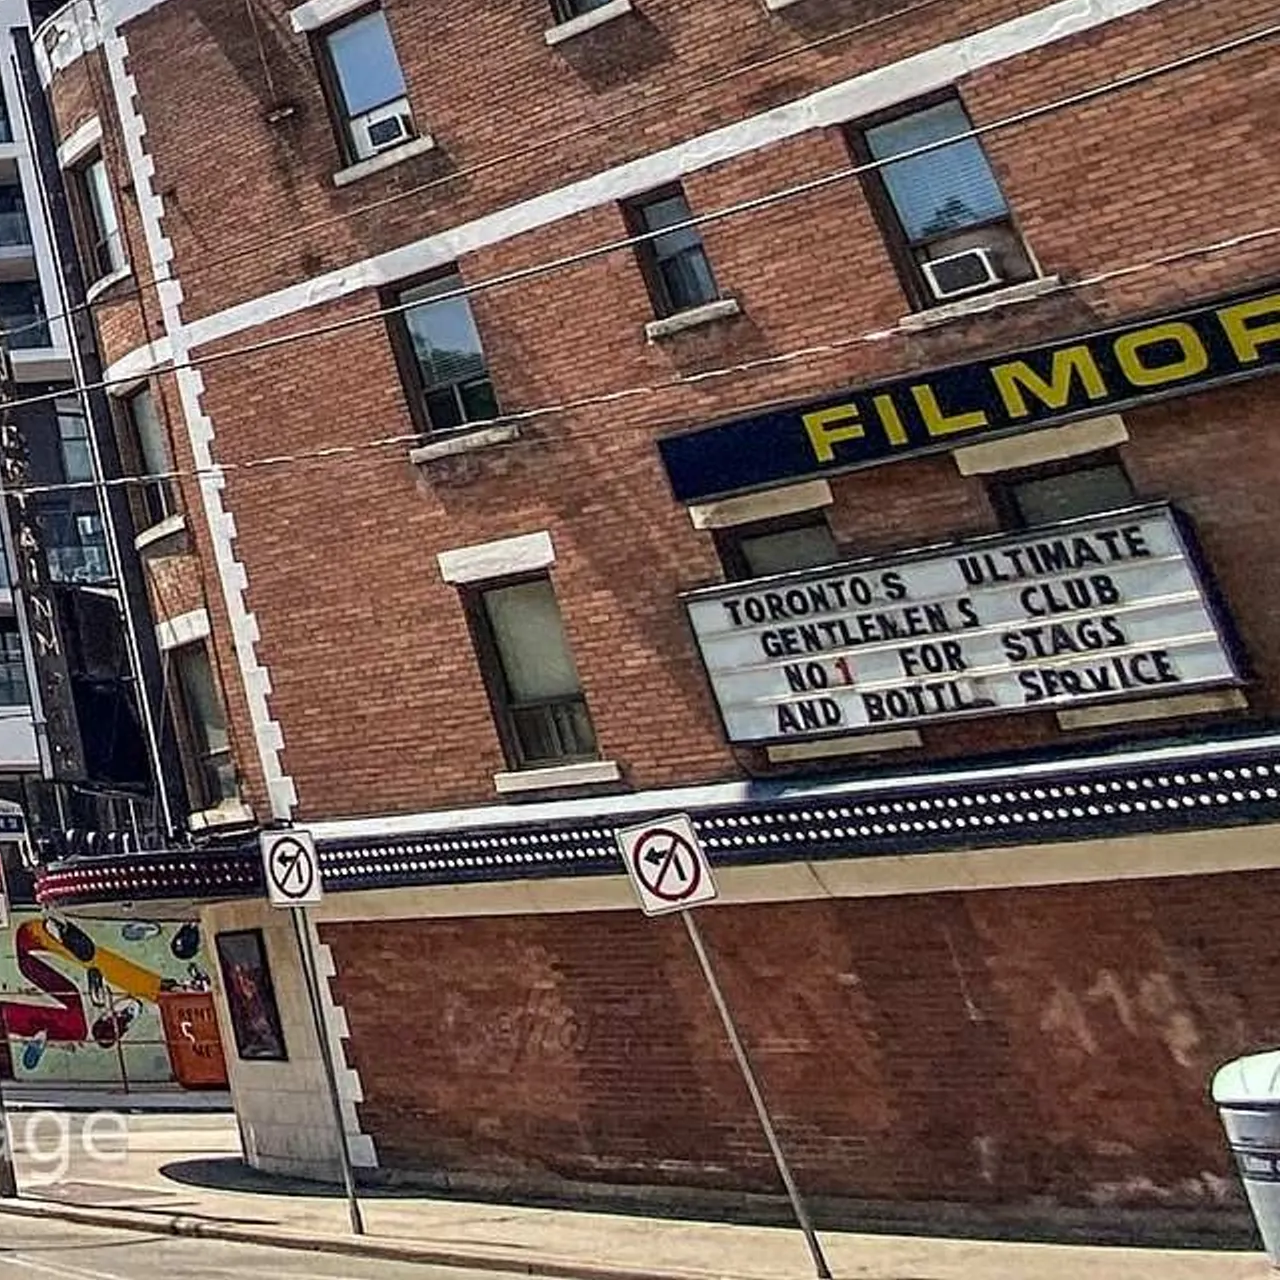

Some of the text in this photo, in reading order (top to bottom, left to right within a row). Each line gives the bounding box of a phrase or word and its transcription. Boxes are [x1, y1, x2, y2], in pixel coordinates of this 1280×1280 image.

[956, 525, 1151, 586] ULTIMATE
[1019, 574, 1121, 616] CLUB
[899, 640, 968, 677] FOR
[1001, 615, 1128, 663] STAGS
[775, 697, 841, 733] AND
[1017, 649, 1182, 703] SERVICE
